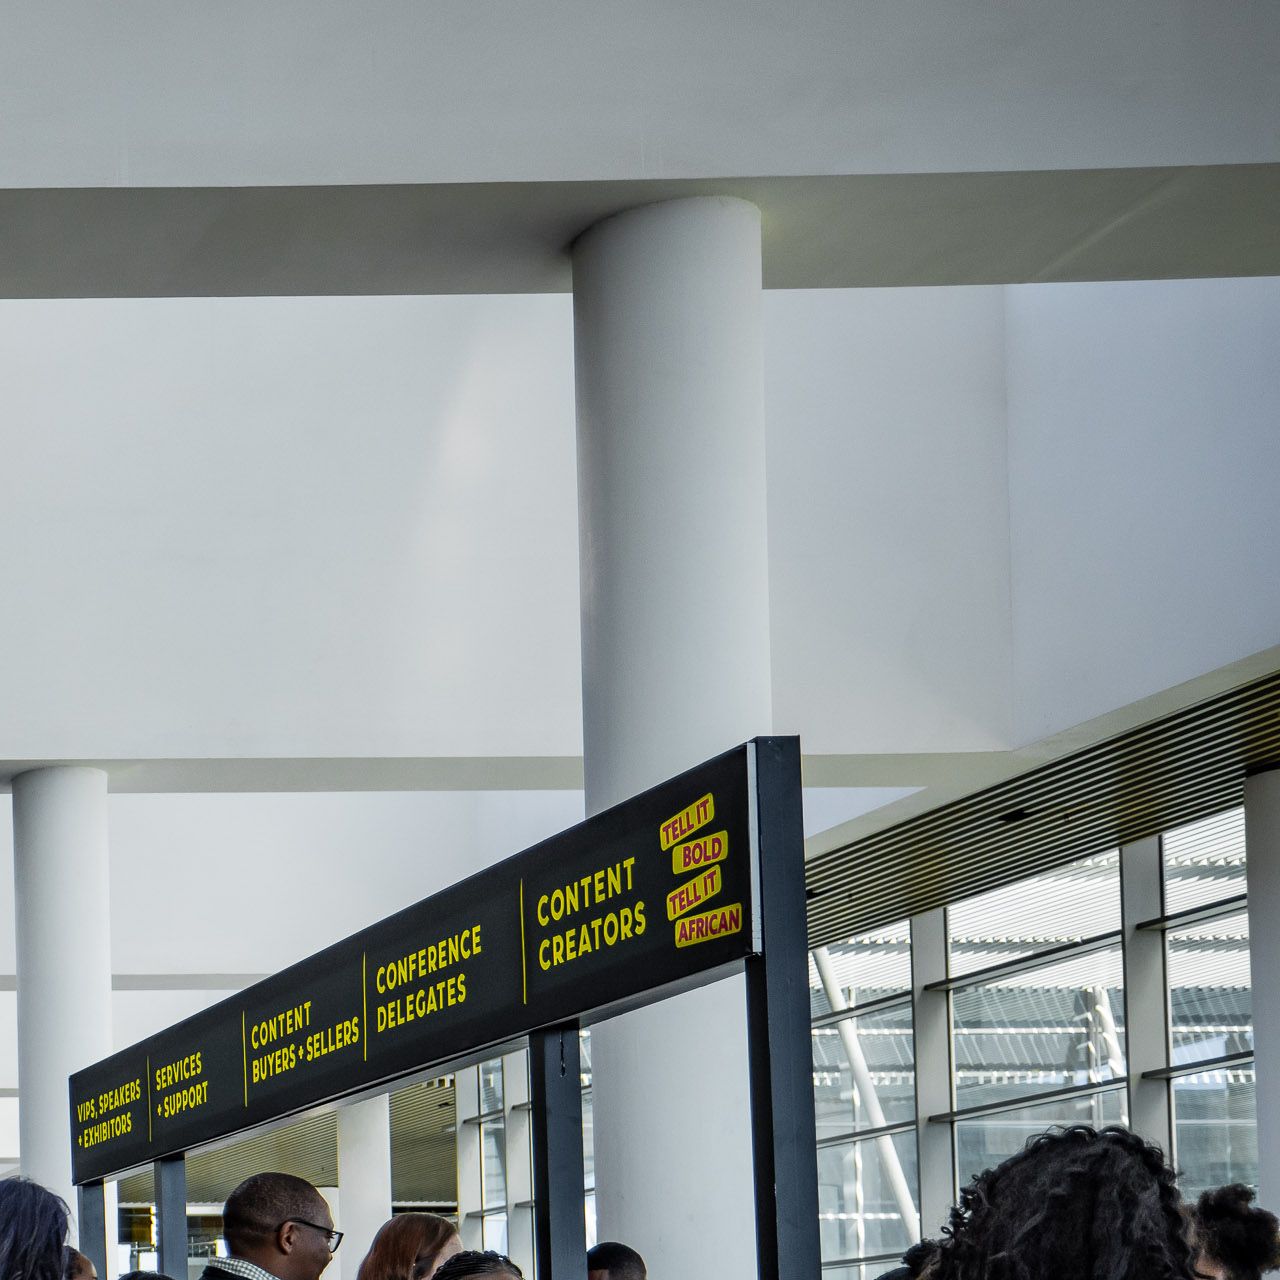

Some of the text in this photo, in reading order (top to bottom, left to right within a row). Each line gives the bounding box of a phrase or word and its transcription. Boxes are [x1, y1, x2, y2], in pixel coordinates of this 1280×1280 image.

[662, 798, 710, 845] TELL IT
[682, 836, 722, 868] BOLD
[537, 856, 635, 927] CONTENT
[669, 869, 717, 915] TELL IT
[539, 900, 646, 971] CREATORS
[678, 907, 740, 943] AFRICAN
[376, 924, 482, 994] CONFERENCE
[251, 1000, 312, 1050] CONTENT
[377, 973, 467, 1033] DELEGATES
[155, 1051, 202, 1091] SERVICES
[252, 1016, 359, 1084] BUYERS + SELLERS
[77, 1078, 141, 1124] VIPS, SPEAKERS
[163, 1080, 208, 1118] SUPPORT
[83, 1111, 132, 1148] EXHIBITORS
